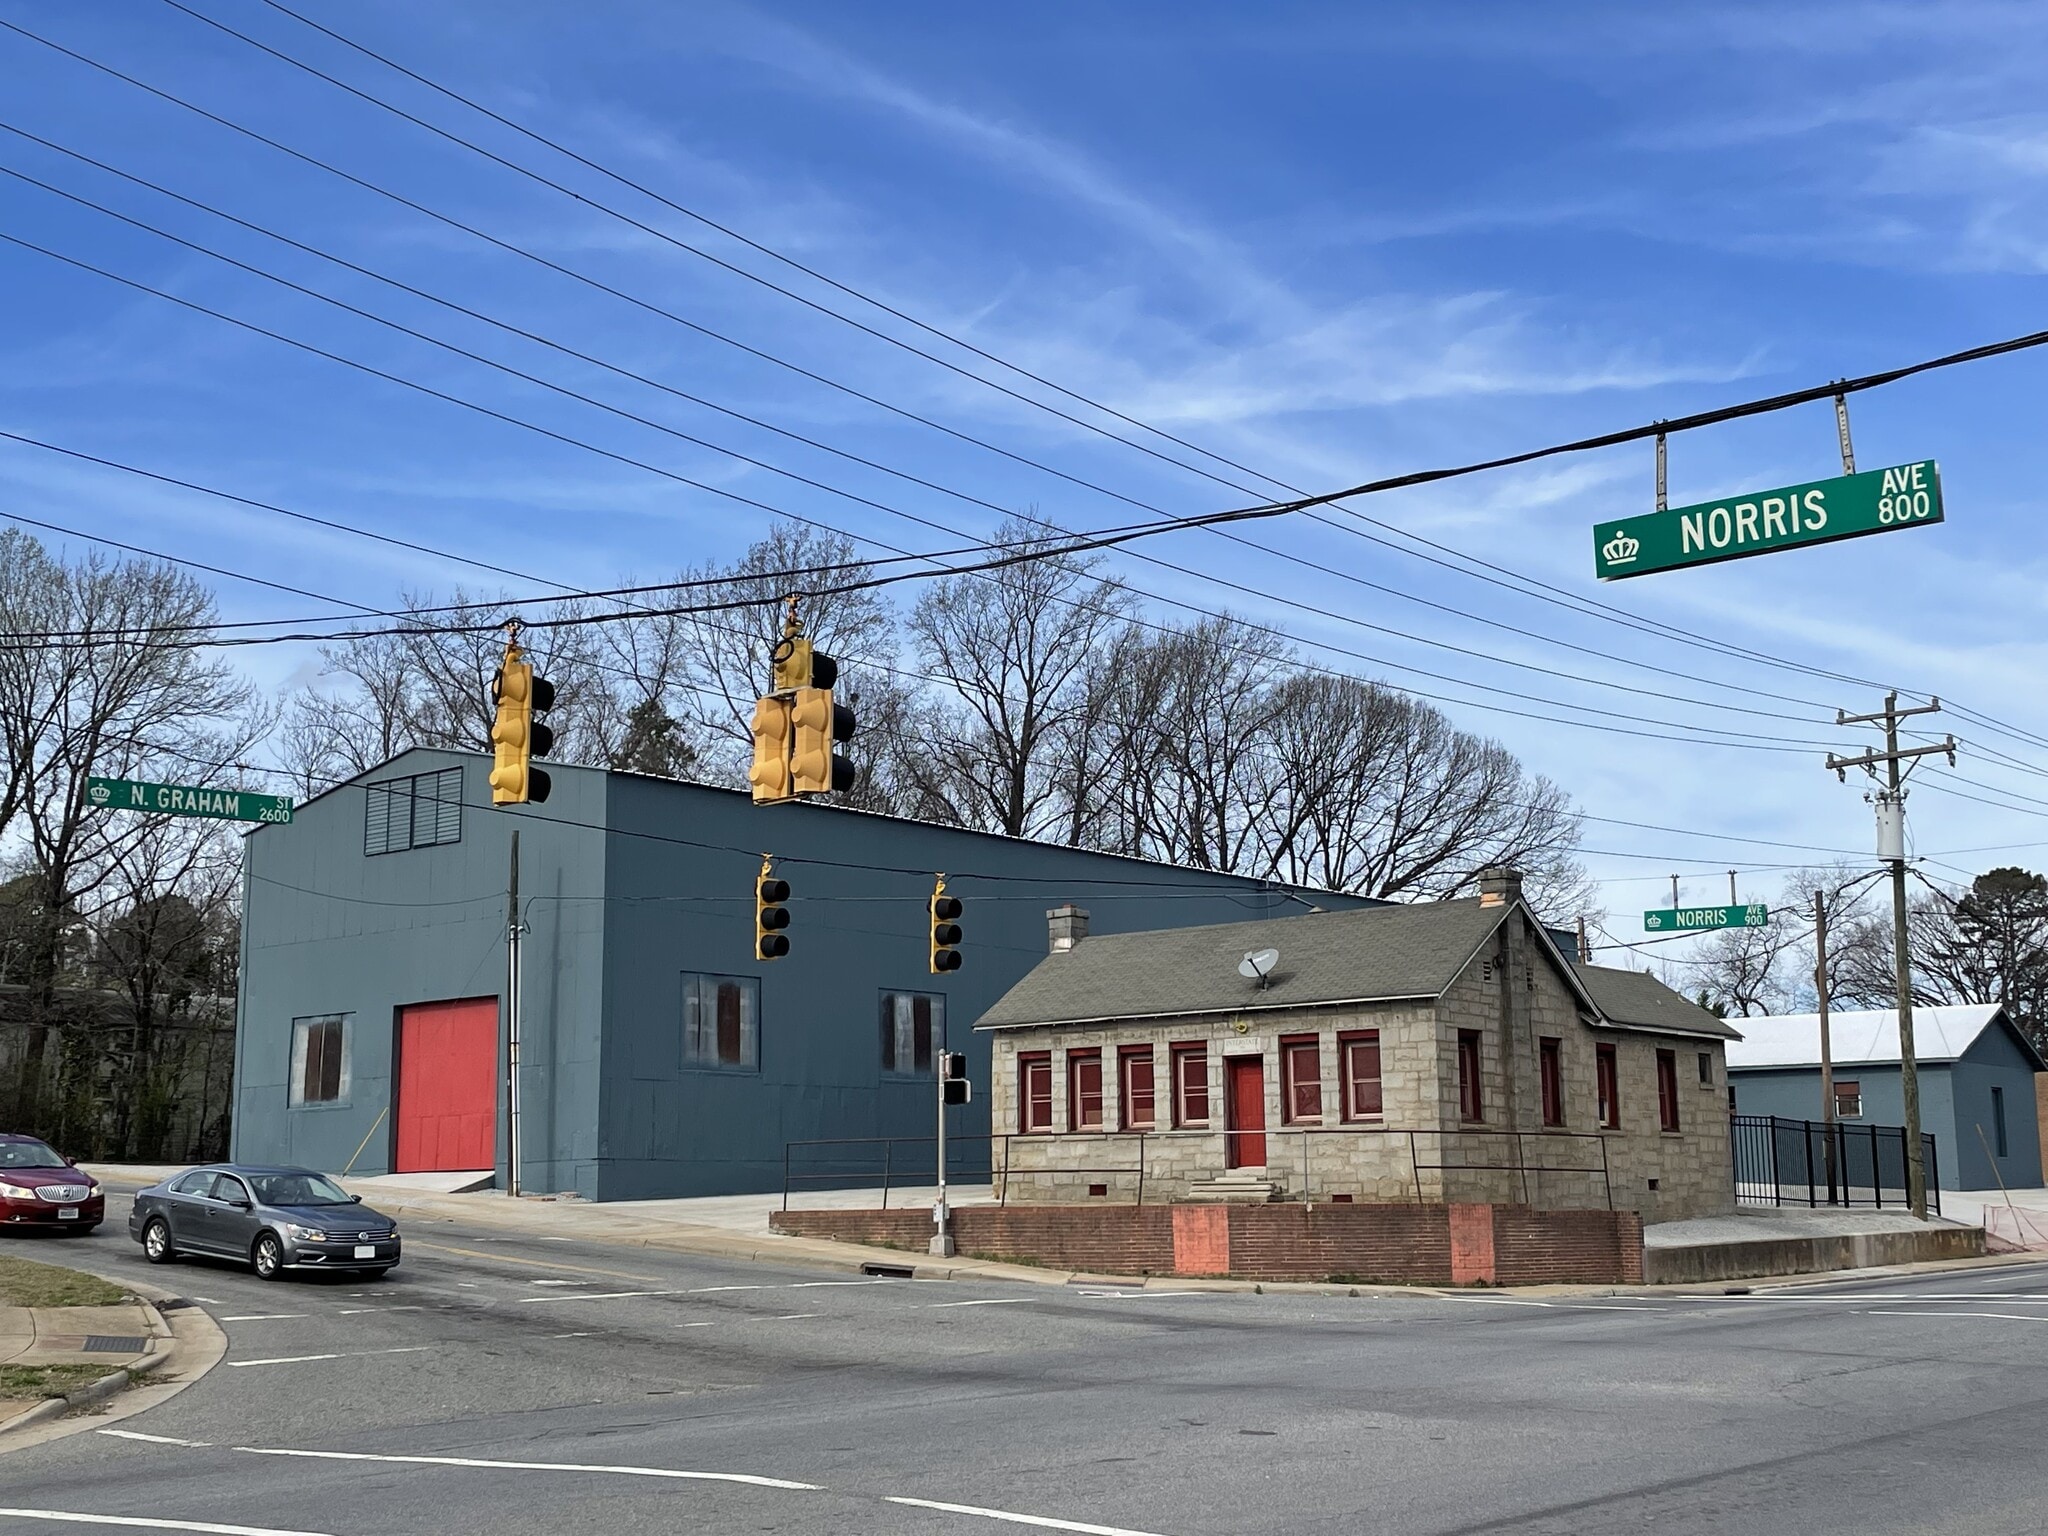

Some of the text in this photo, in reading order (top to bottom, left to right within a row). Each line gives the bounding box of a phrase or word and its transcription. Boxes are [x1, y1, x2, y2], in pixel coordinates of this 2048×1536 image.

[1881, 463, 1927, 496] AVE
[1878, 491, 1930, 524] 800
[1681, 490, 1827, 554] NORRIS
[131, 785, 239, 816] N. GRAHAM
[276, 797, 289, 808] ST
[259, 808, 289, 822] 2600
[1676, 909, 1727, 926] NORRIS
[1746, 905, 1762, 915] AVE
[1744, 915, 1763, 926] 900
